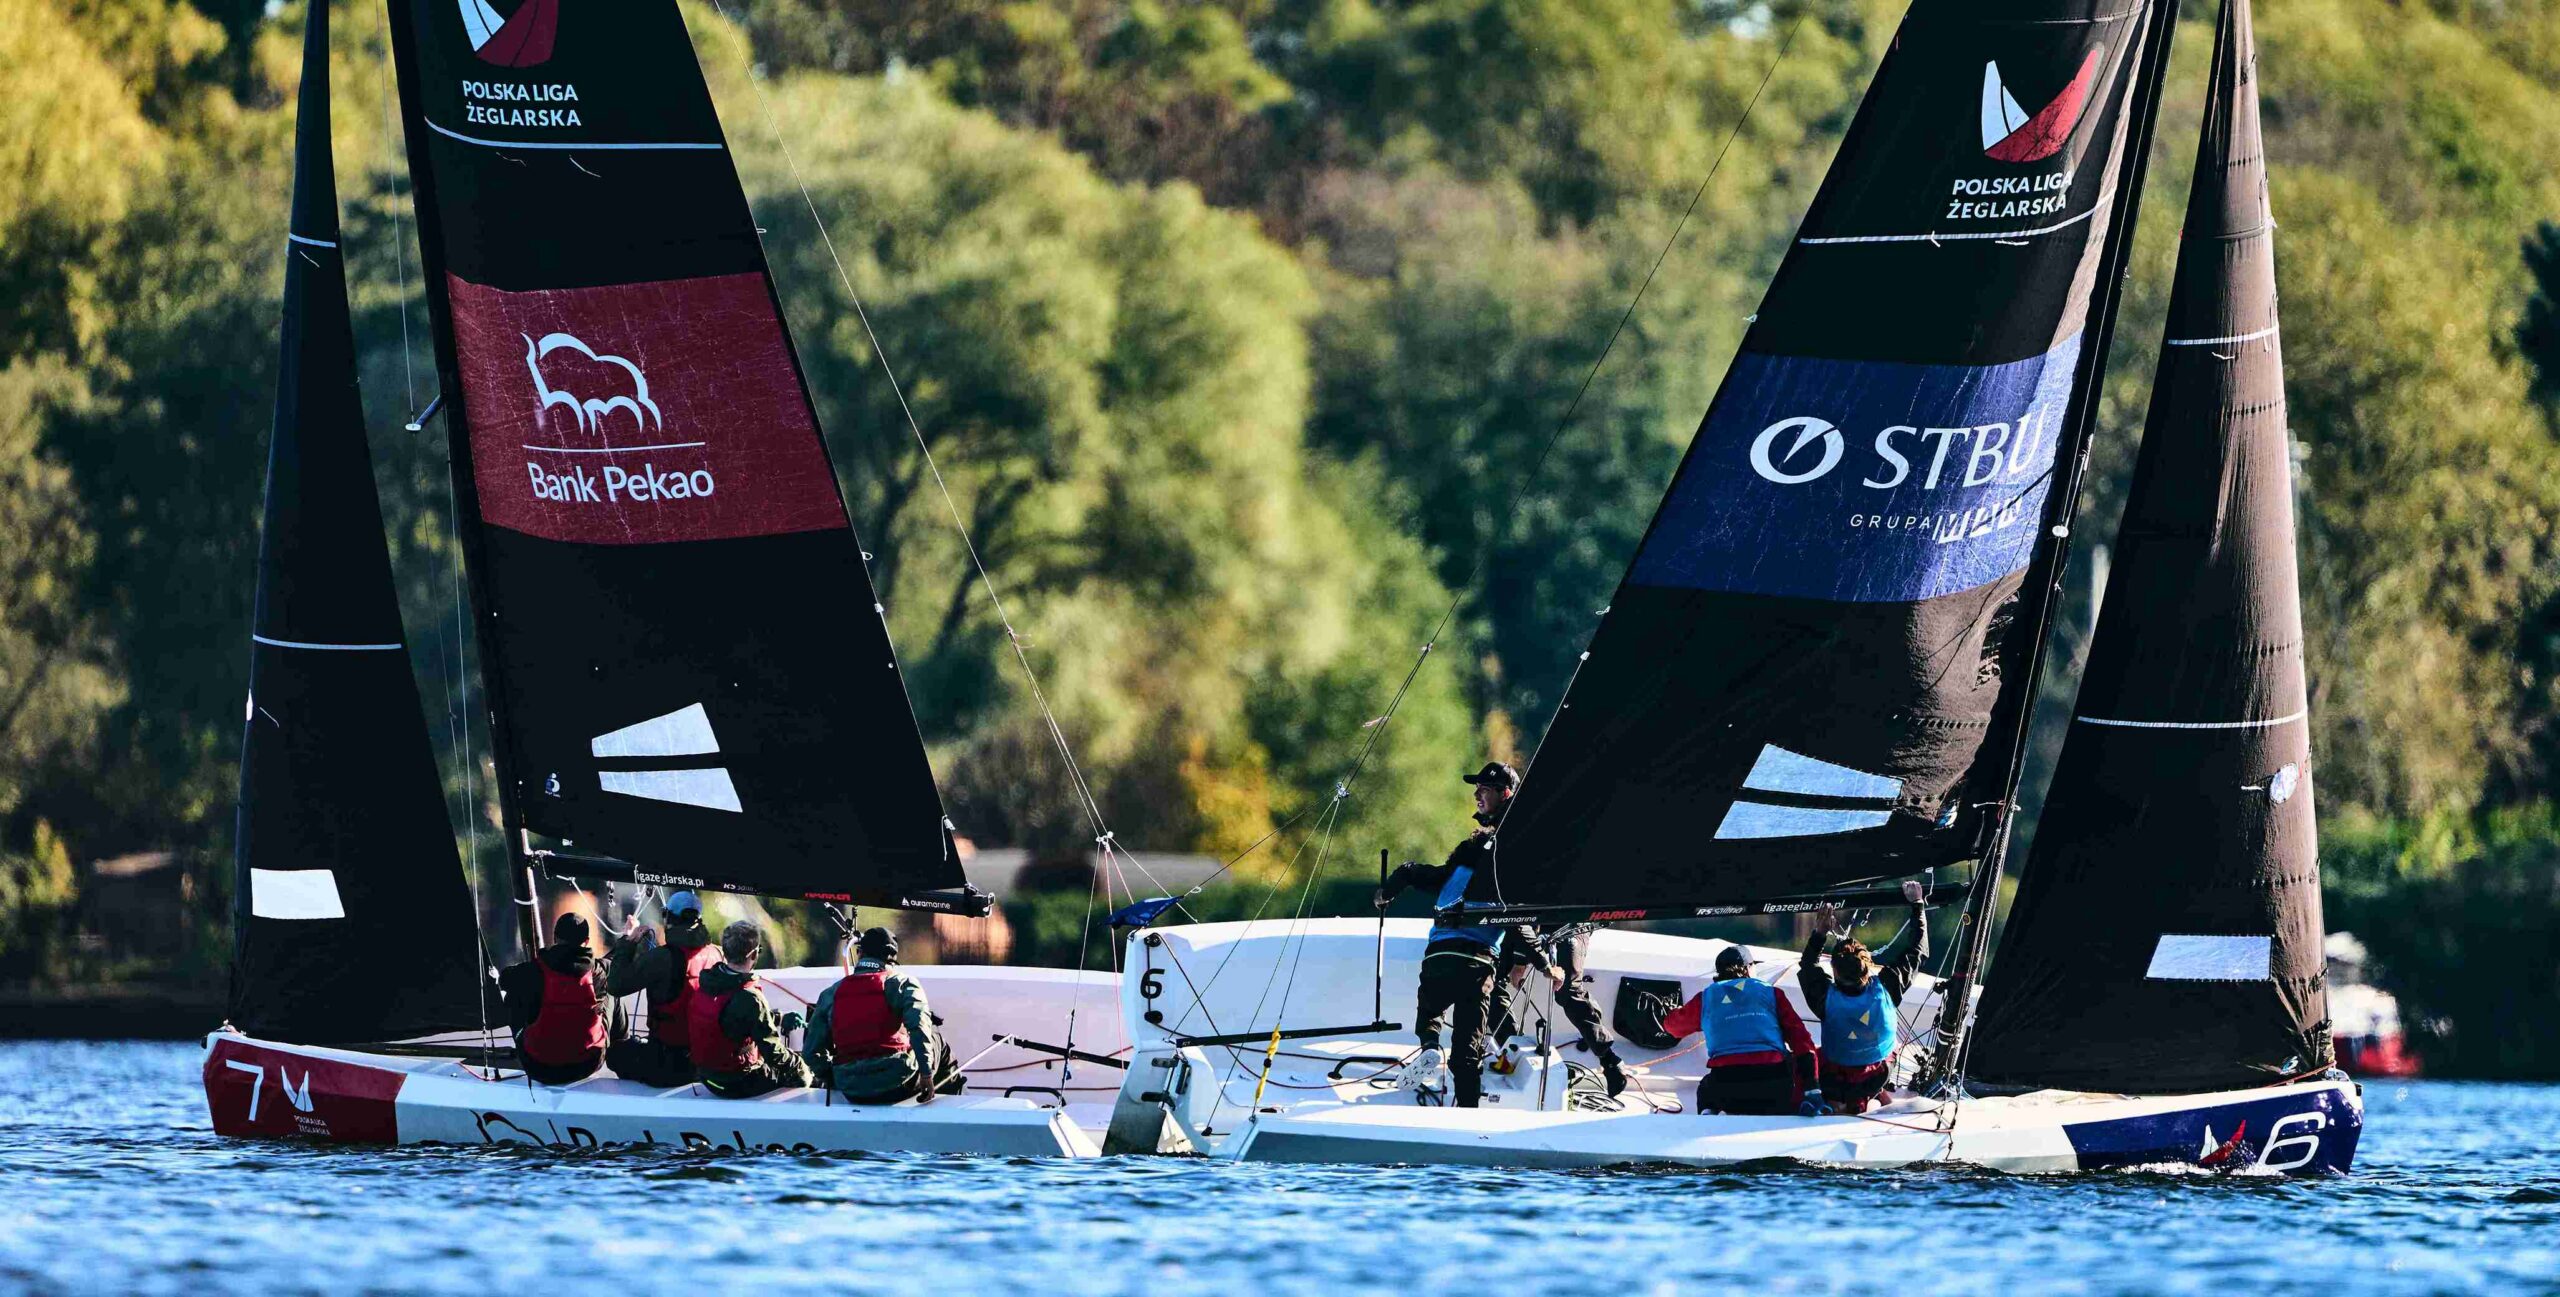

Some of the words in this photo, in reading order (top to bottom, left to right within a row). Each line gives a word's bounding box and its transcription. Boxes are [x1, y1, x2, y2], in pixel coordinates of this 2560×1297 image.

[462, 80, 530, 101] POLSKA
[533, 84, 579, 102] LIGA
[466, 101, 582, 127] ŻEGLARSKA
[1952, 176, 2030, 196] POLSKA
[2033, 170, 2074, 193] LIGA
[1946, 195, 2067, 219] ŻEGLARSKA
[1862, 403, 2050, 490] STBU
[526, 462, 601, 503] Bank
[602, 463, 715, 503] Pekao
[1850, 513, 1931, 530] GRUPA
[910, 899, 952, 910] auramarine
[1587, 909, 1648, 921] HARKEN
[1490, 915, 1537, 924] auramarine
[1140, 968, 1166, 1000] 6
[226, 1059, 264, 1122] 7
[2256, 1111, 2327, 1172] 6
